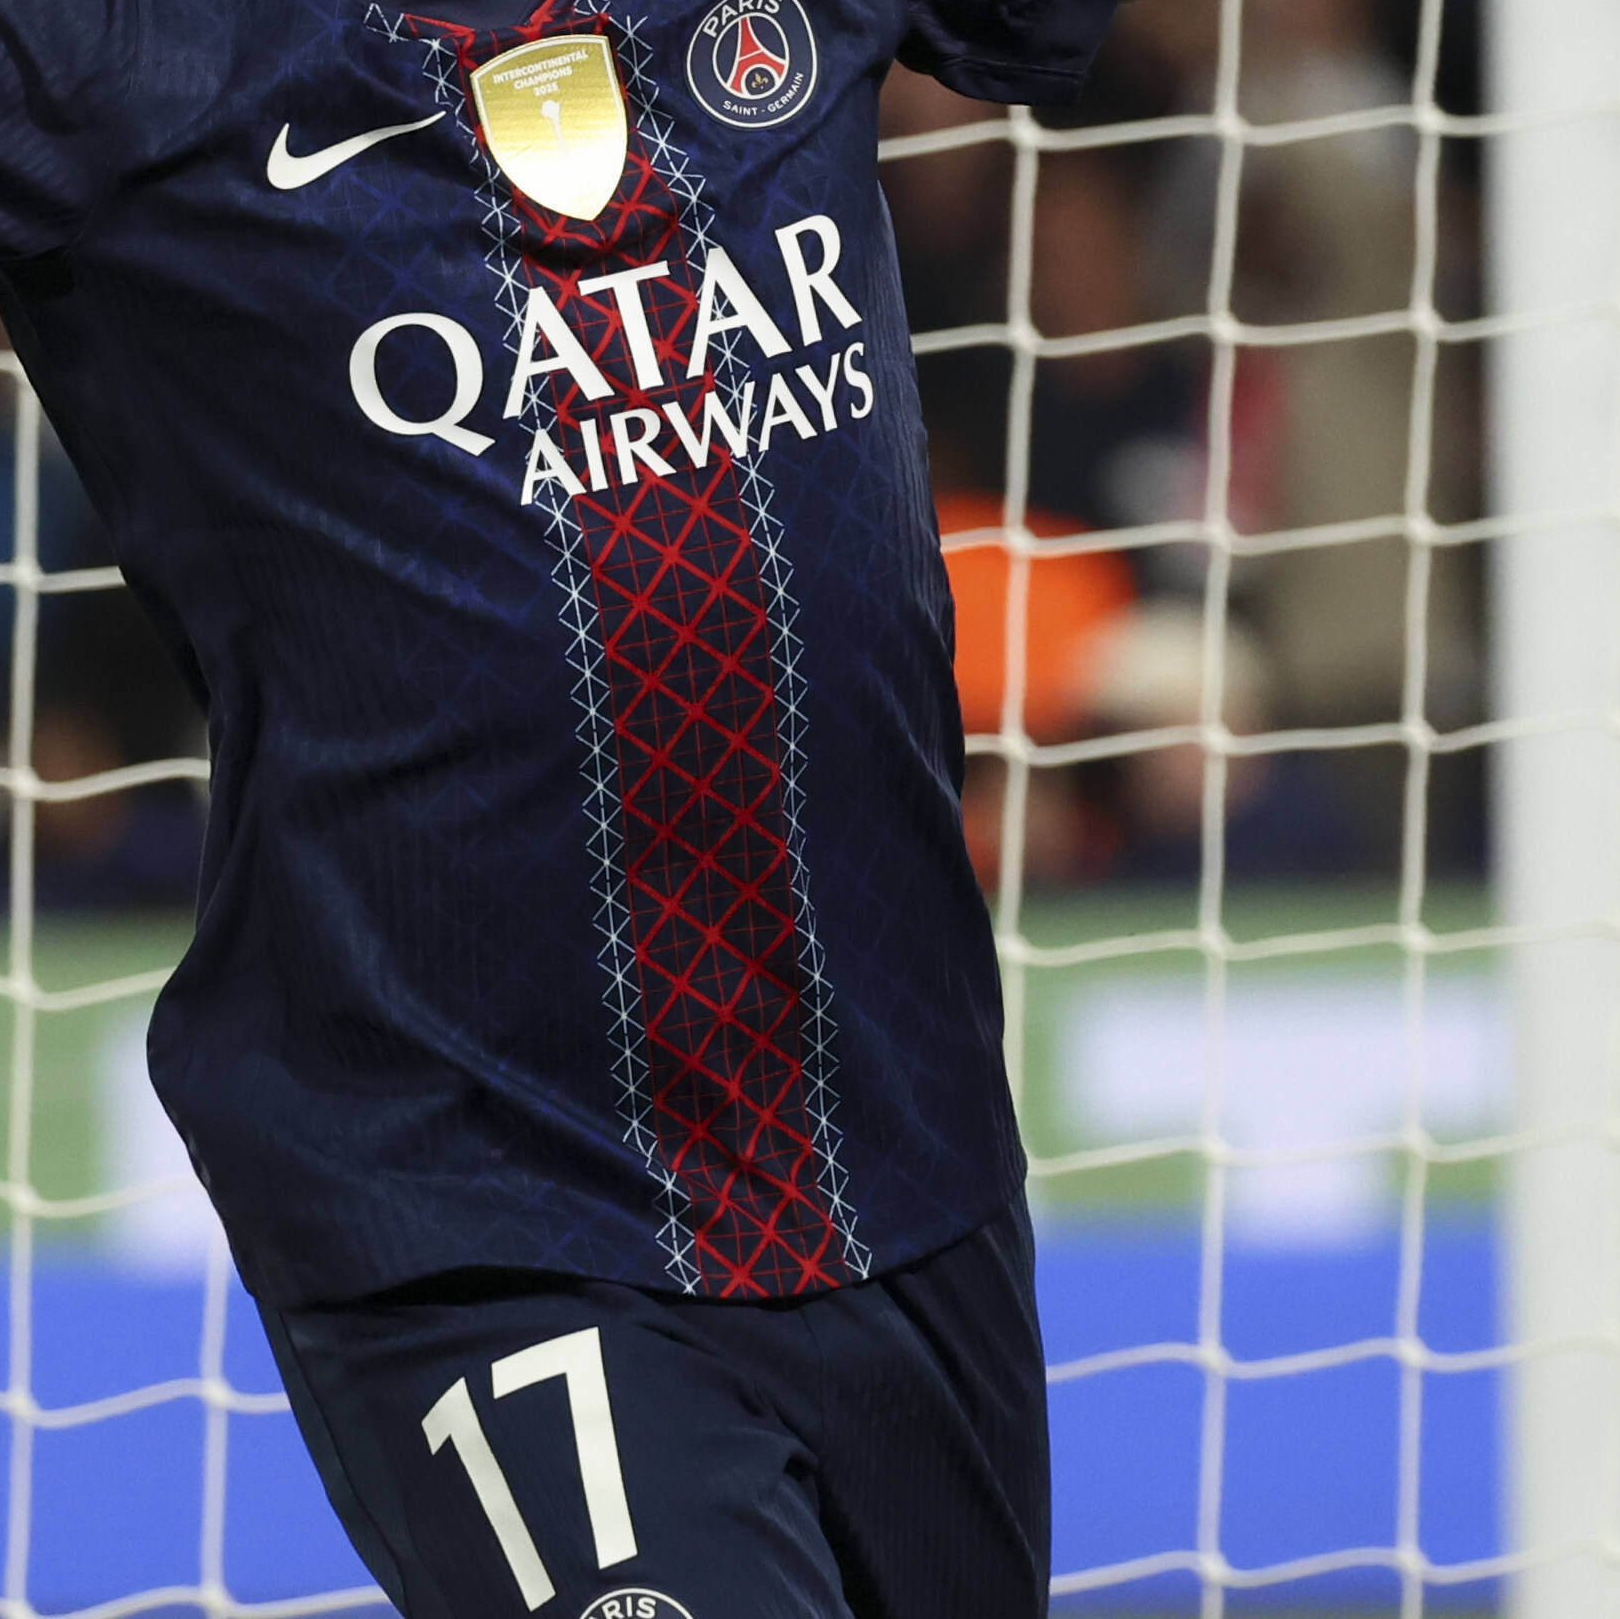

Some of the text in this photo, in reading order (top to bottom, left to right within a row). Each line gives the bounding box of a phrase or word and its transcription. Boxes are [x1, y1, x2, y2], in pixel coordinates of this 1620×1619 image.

[492, 48, 589, 84] INTERCONTINENTAL
[513, 65, 573, 89] CHAMPIONS
[348, 213, 863, 457] QATAR
[519, 342, 874, 505] AIRWAYS
[421, 1326, 638, 1613] 17
[588, 1595, 657, 1619] RIS
